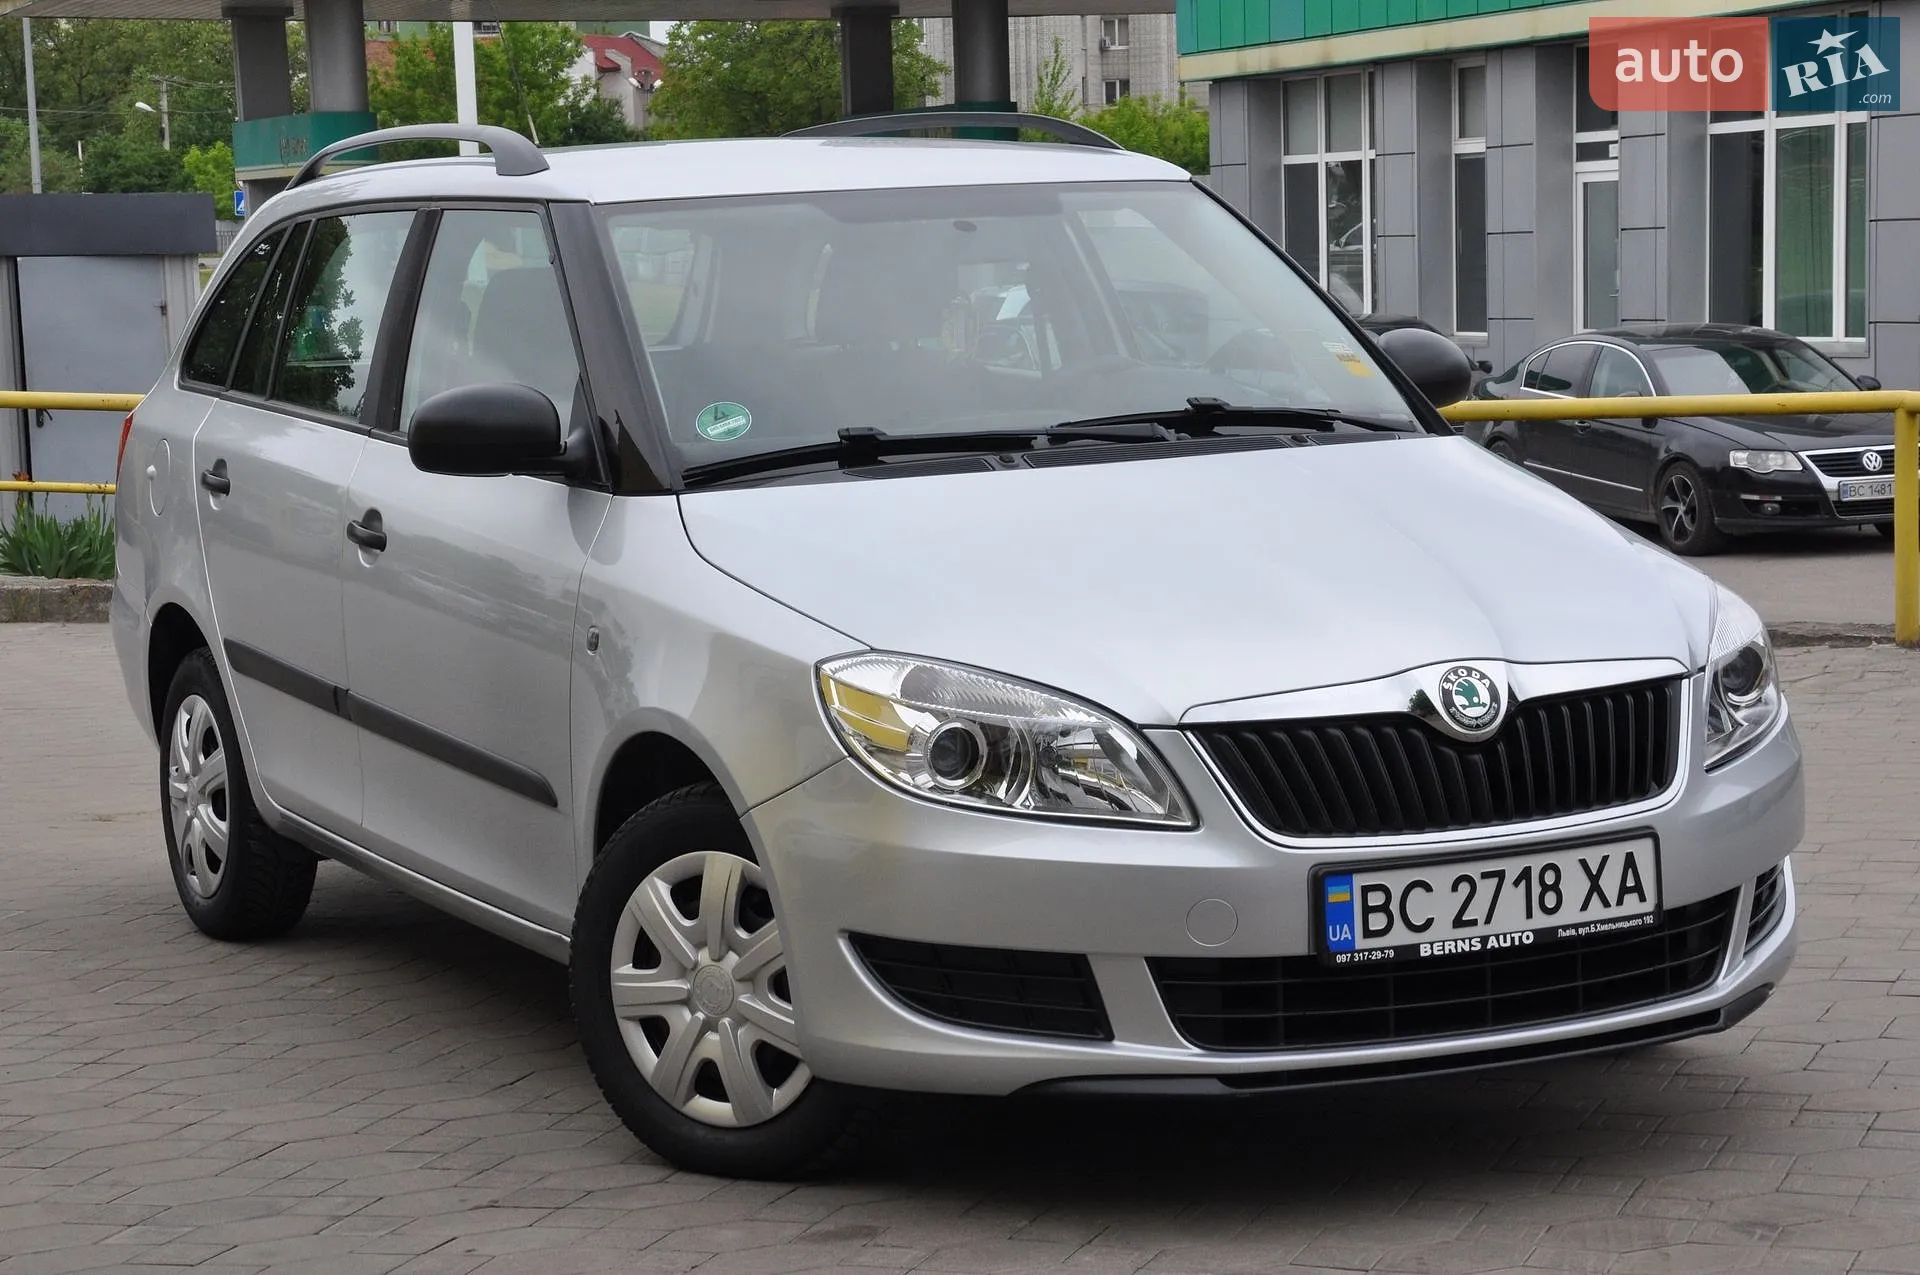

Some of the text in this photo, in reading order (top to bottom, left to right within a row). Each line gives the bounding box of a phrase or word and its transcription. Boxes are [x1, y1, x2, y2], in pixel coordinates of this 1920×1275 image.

[1849, 483, 1892, 497] BC 1481
[1442, 668, 1491, 691] SKODA
[1360, 851, 1648, 939] BC 2718 XA
[1328, 923, 1352, 942] UA
[1420, 931, 1535, 957] BERNS AUTO
[1336, 950, 1395, 963] 097 317-29-79
